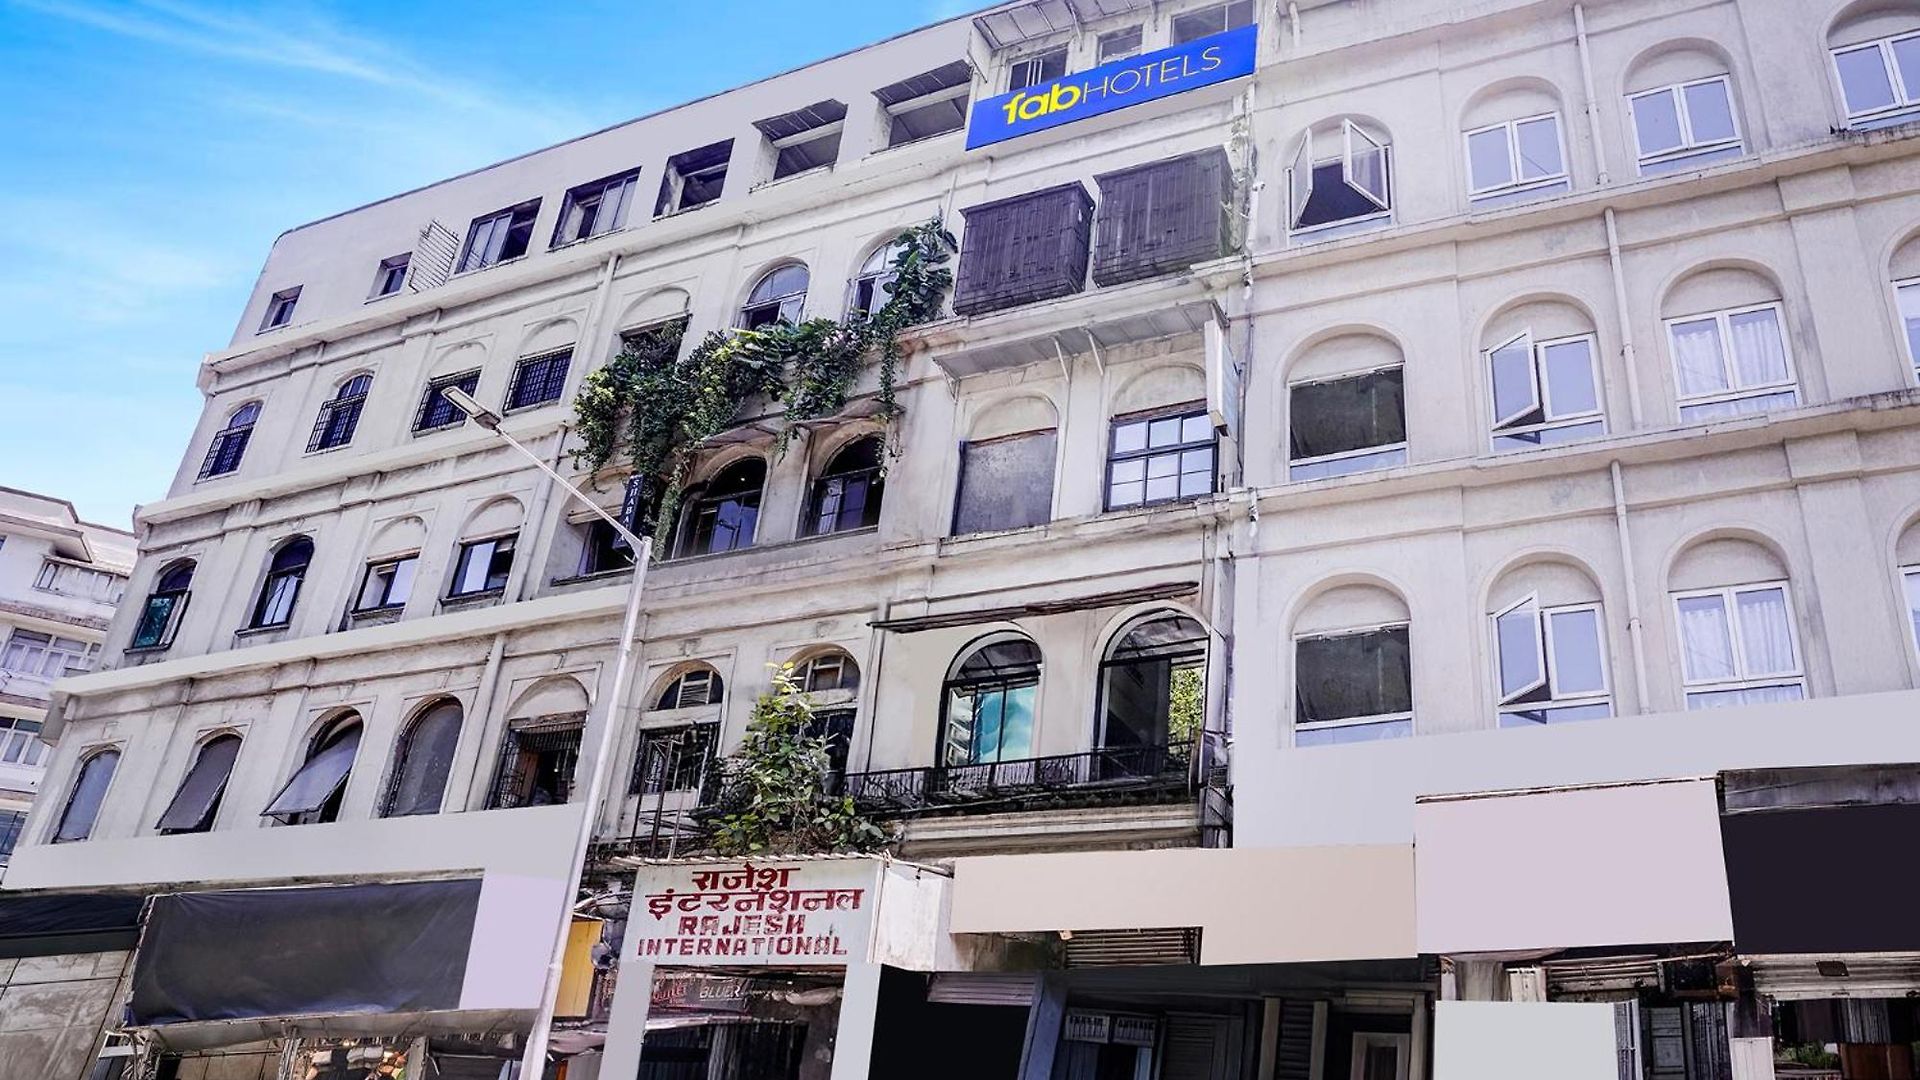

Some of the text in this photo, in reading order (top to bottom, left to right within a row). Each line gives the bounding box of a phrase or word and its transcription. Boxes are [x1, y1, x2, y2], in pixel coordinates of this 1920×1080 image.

[617, 479, 640, 542] SHABAA
[692, 862, 801, 892] राजेश
[678, 914, 806, 936] RAJESH
[637, 936, 848, 956] INTERNATIONAL
